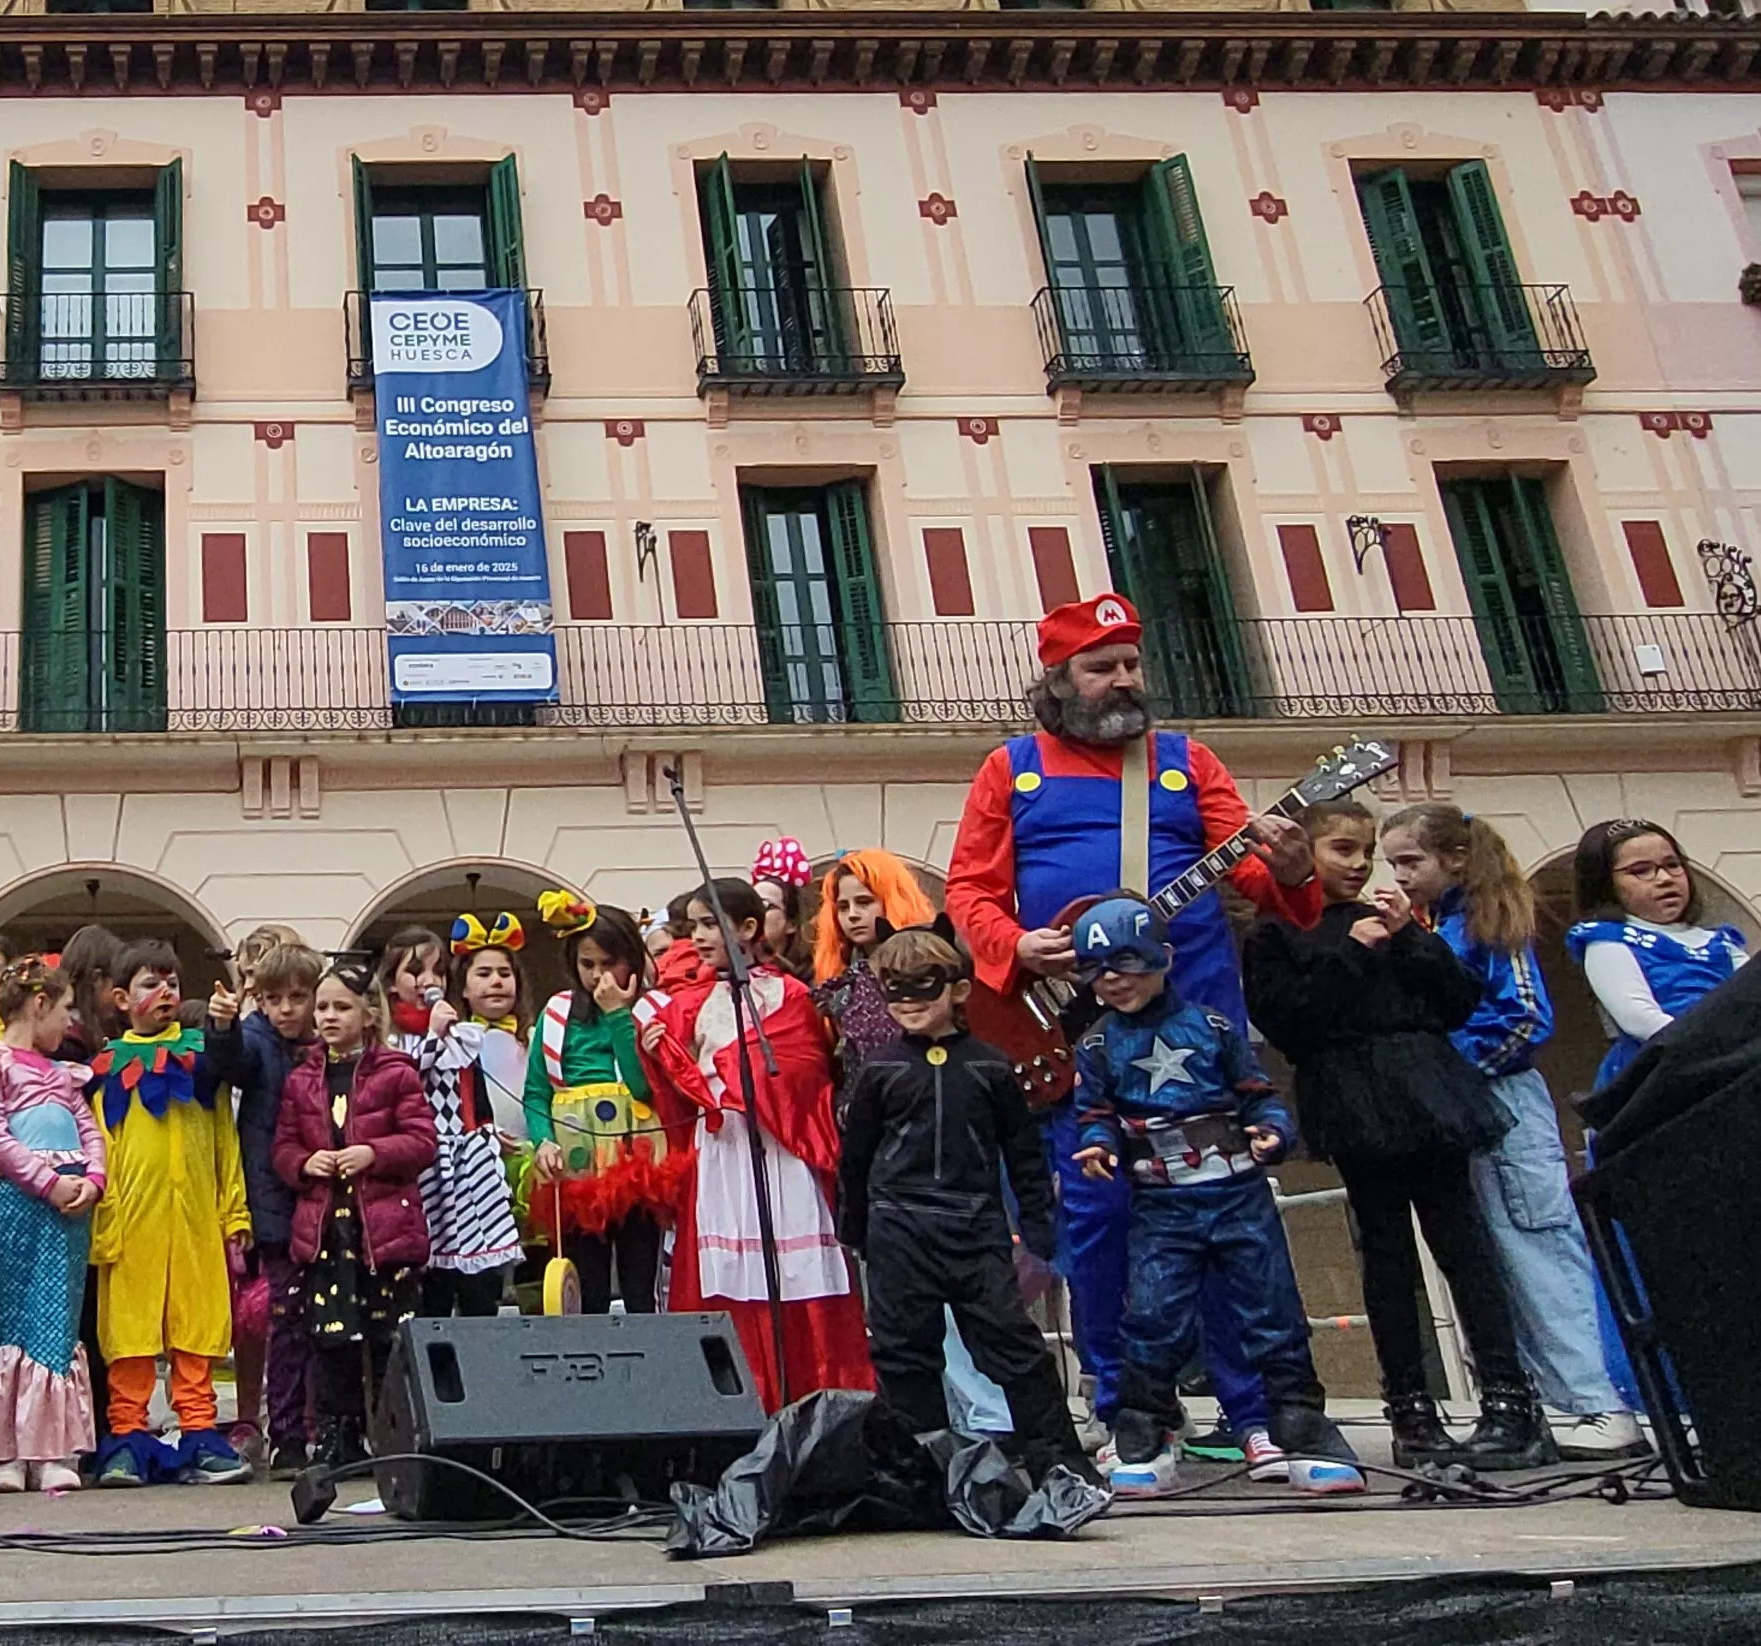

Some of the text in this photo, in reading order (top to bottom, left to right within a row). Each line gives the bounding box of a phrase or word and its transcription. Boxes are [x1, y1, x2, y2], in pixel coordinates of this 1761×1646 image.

[389, 312, 470, 331] CEOE
[390, 334, 472, 347] CEPYME
[391, 349, 473, 361] HUESCA
[396, 396, 515, 416] III Congreso
[385, 416, 529, 437] Económico del
[404, 442, 513, 462] Altoaragón
[405, 498, 519, 513] LA EMPRESA:
[390, 516, 537, 532] Clave del desarrollo
[403, 533, 527, 548] socioeconómico
[415, 562, 519, 574] 16 de enero de 2025
[519, 1351, 646, 1382] FBT
